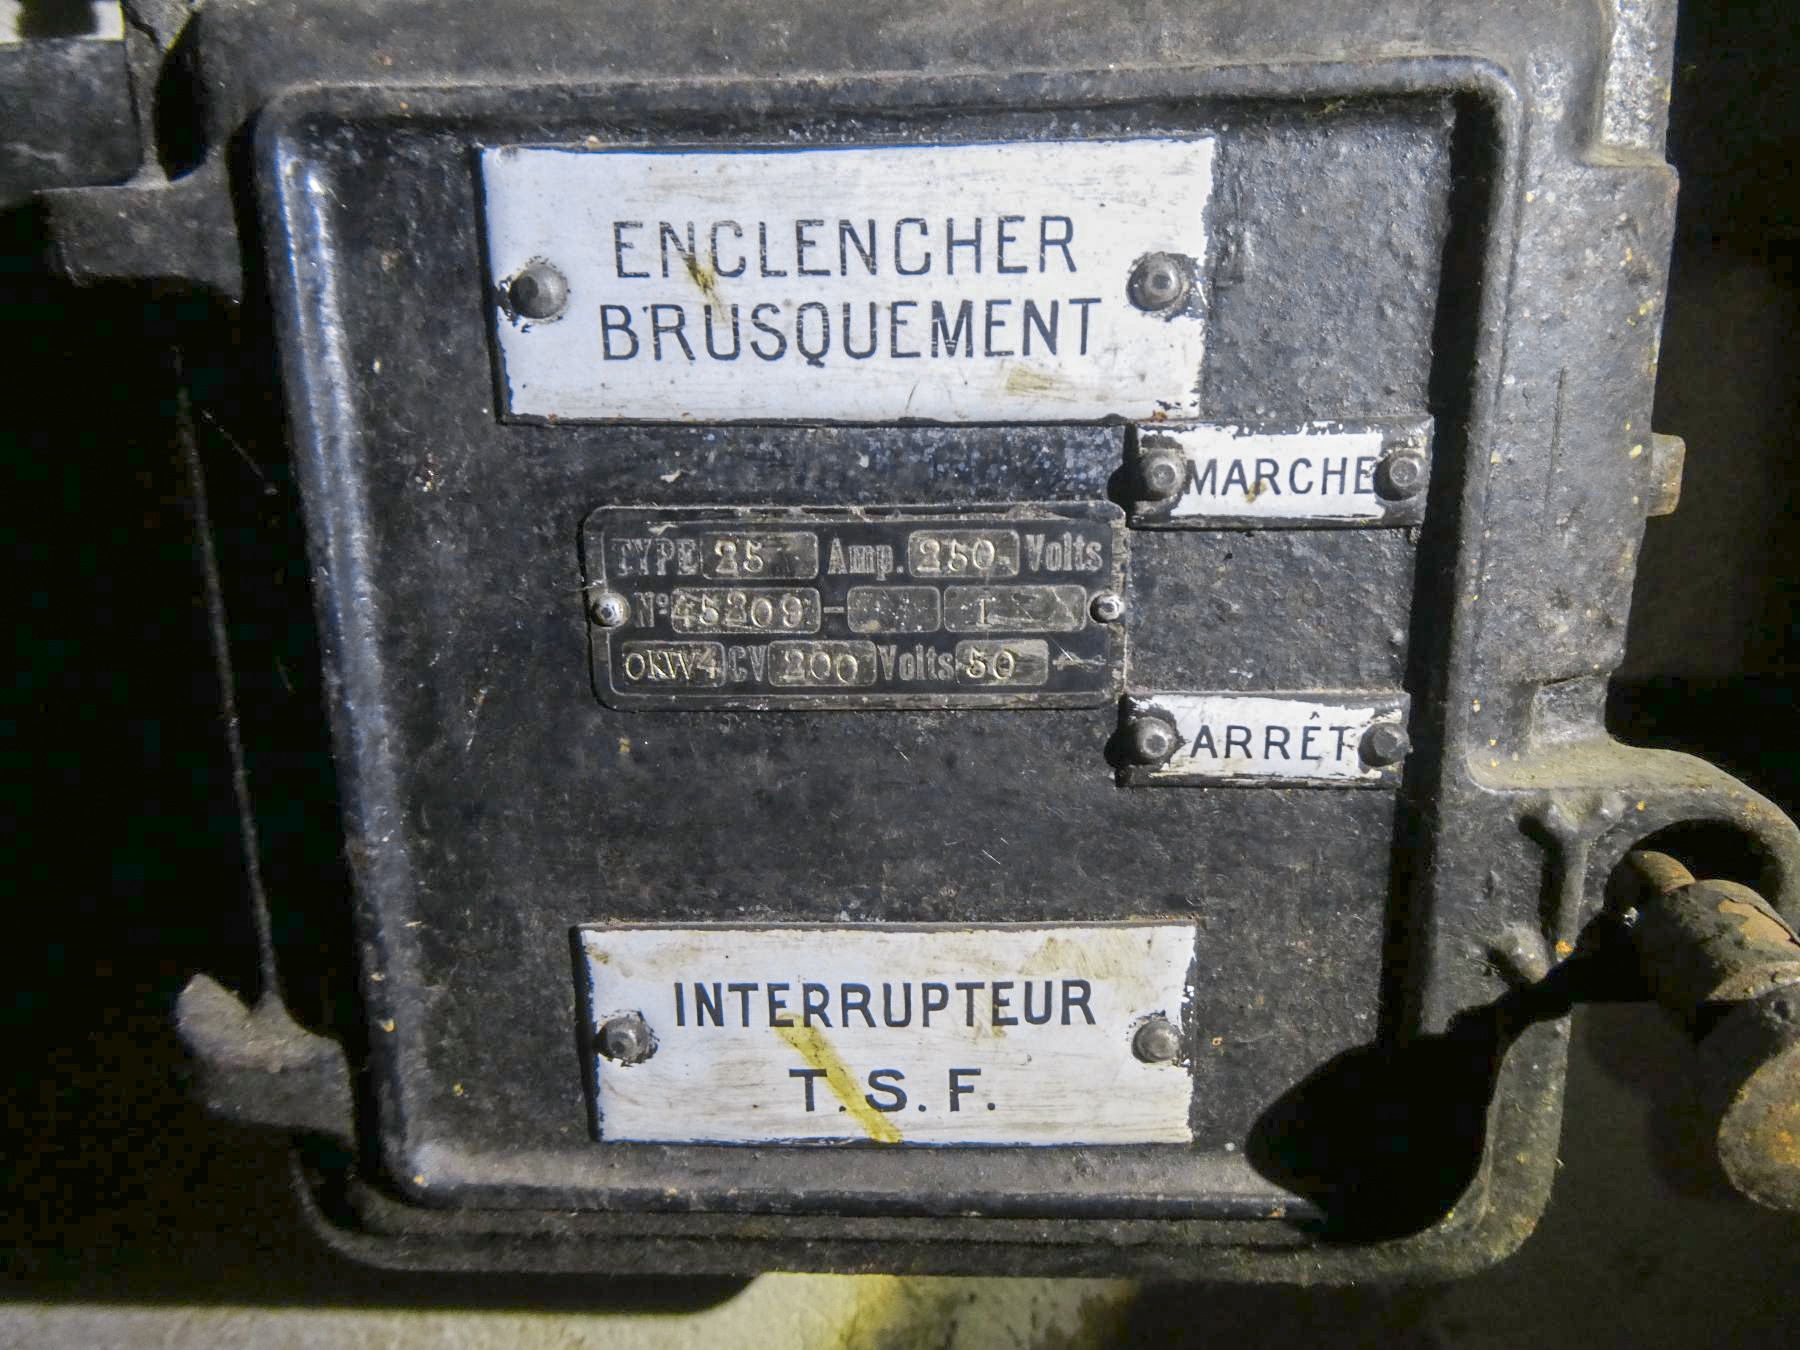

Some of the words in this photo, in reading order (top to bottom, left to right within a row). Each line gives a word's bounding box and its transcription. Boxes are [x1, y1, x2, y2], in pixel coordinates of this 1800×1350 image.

[612, 215, 1077, 279] ENCLENCHER
[600, 296, 1102, 367] BRUSQUEMENT
[1183, 456, 1378, 496] MARCHE
[612, 537, 699, 577] TYPE
[714, 540, 764, 574] 25
[827, 537, 904, 581] Amp.
[916, 538, 996, 573] 250
[1025, 531, 1104, 573] Volts
[728, 645, 768, 682] CV
[783, 649, 859, 684] 200
[877, 643, 956, 681] Volts
[966, 647, 1015, 680] 50
[1190, 711, 1354, 761] ARRÊT
[673, 978, 1097, 1028] INTERRUPTEUR
